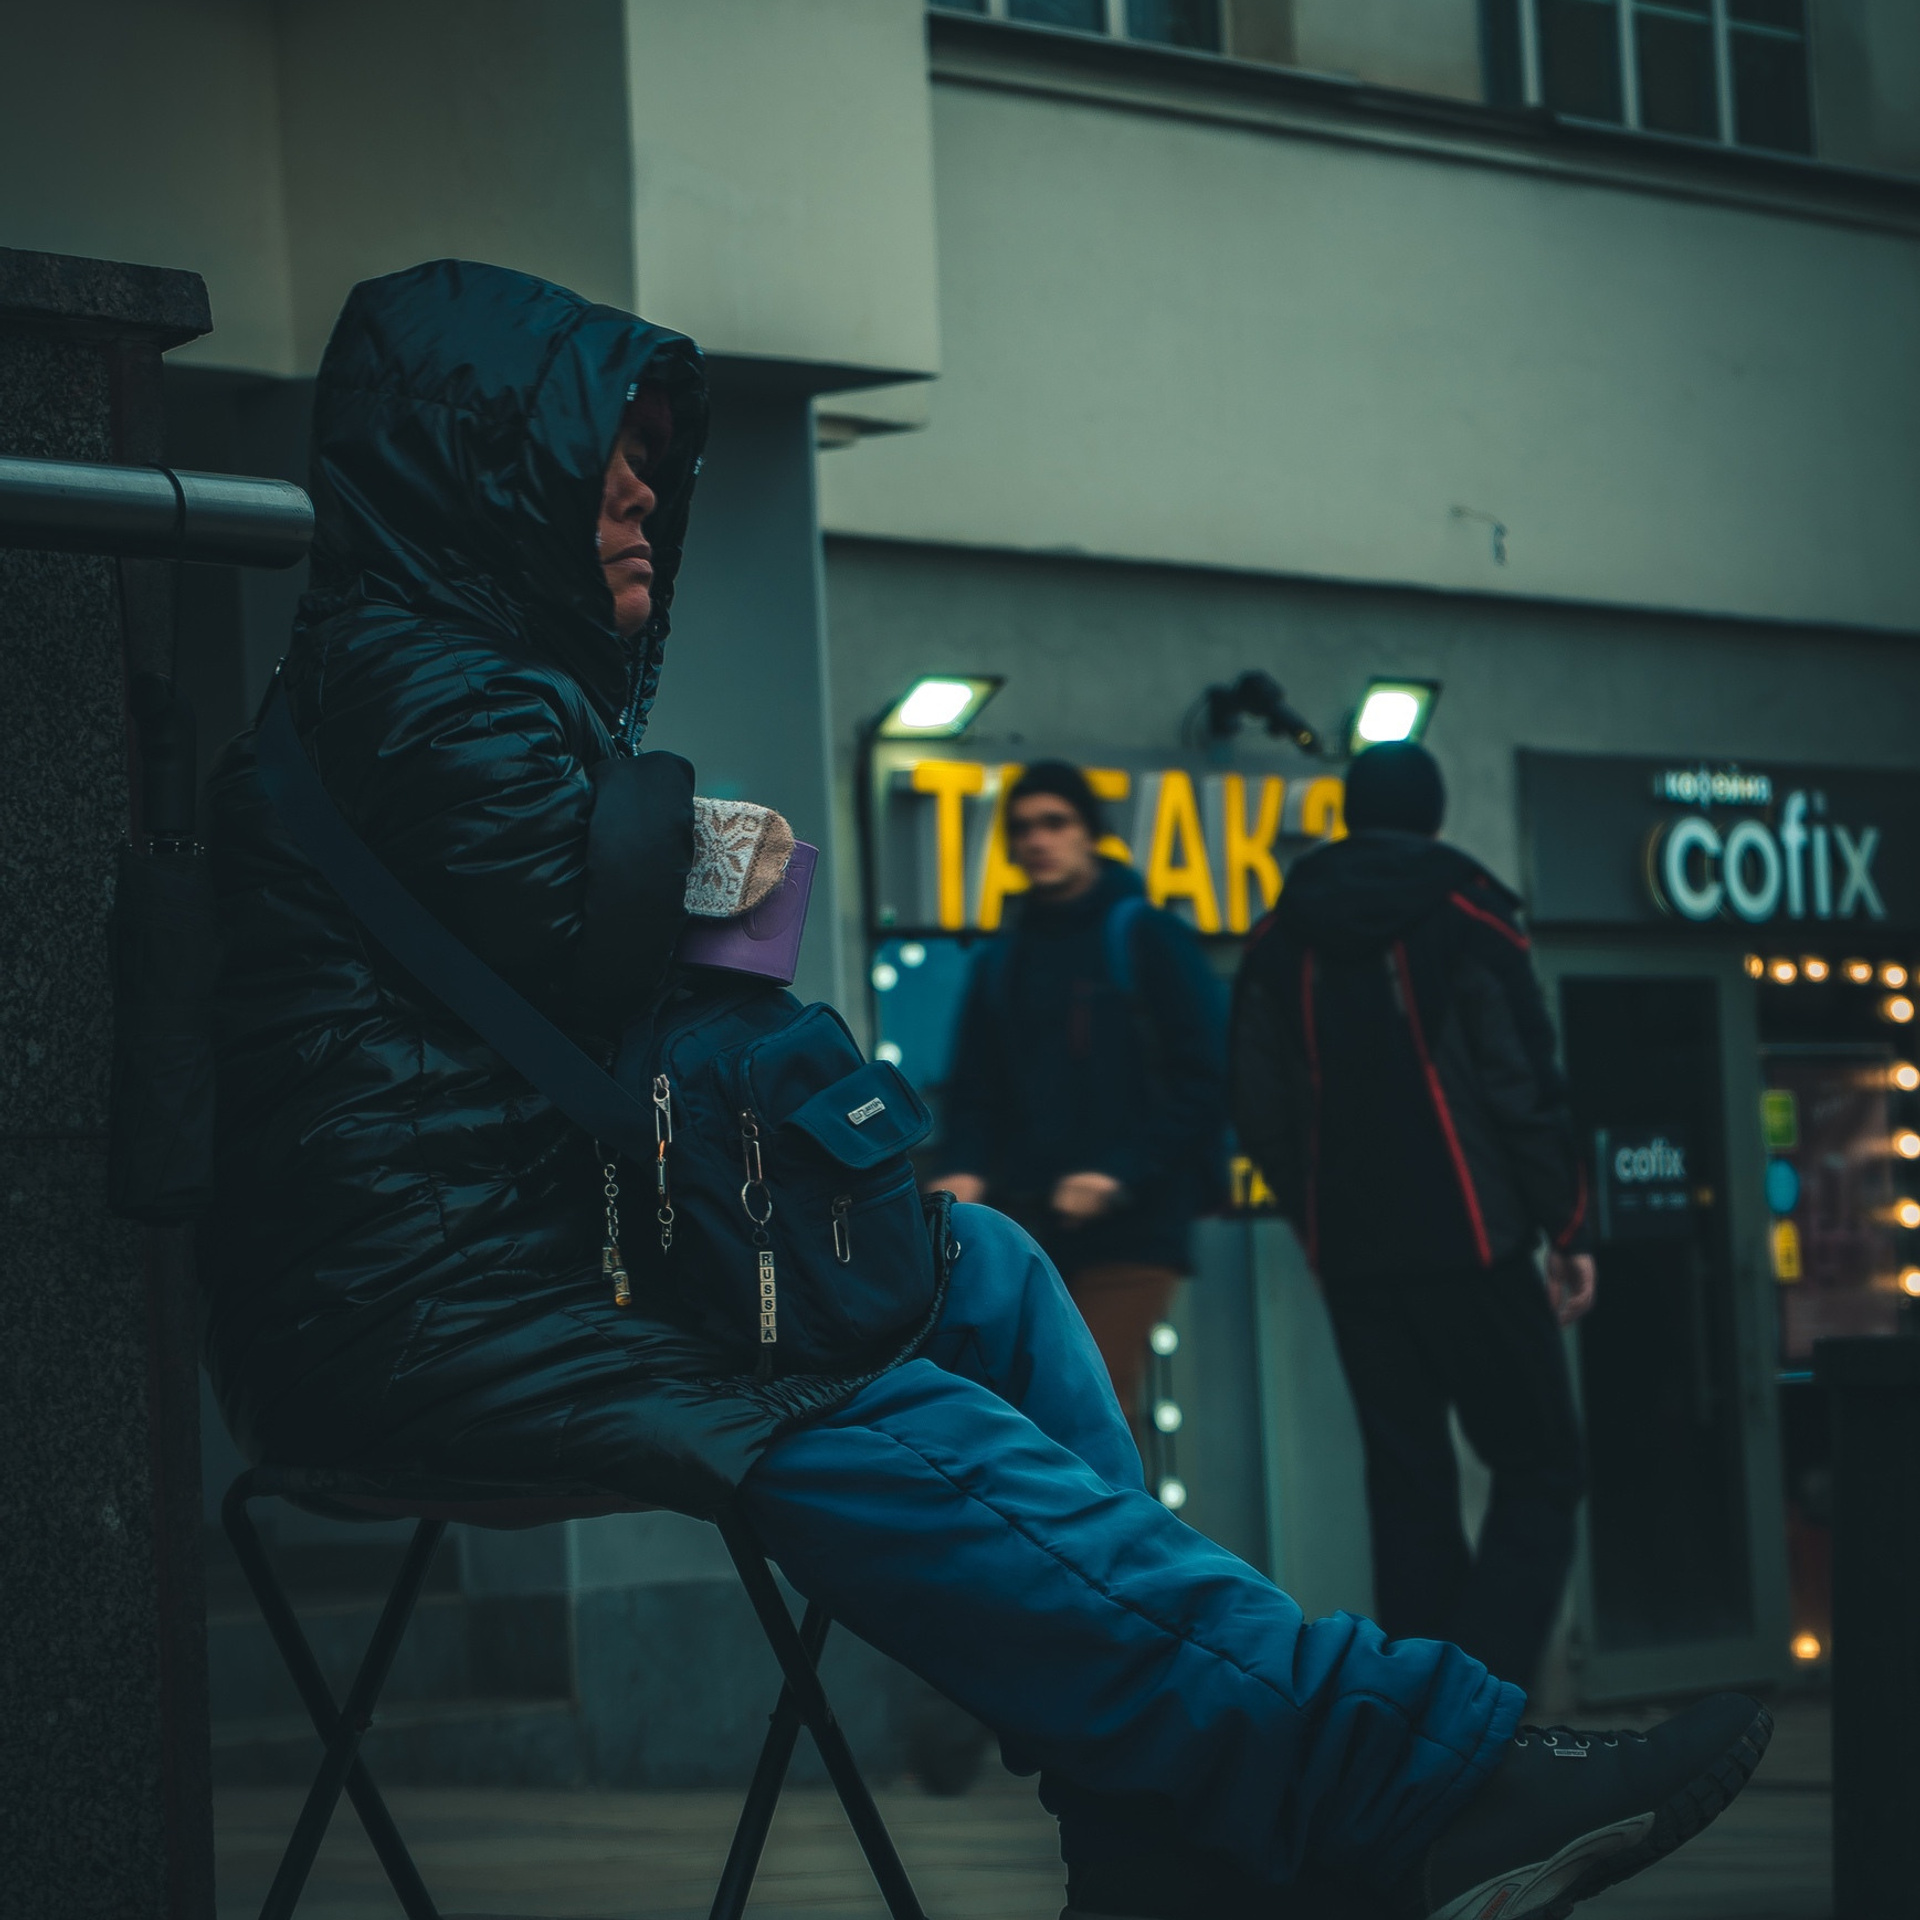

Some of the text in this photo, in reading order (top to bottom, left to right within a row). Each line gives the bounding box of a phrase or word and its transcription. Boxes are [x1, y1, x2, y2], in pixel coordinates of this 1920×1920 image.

[1664, 790, 1886, 921] cofix
[1615, 1138, 1686, 1181] cofix
[760, 1252, 776, 1342] RUSSIA
